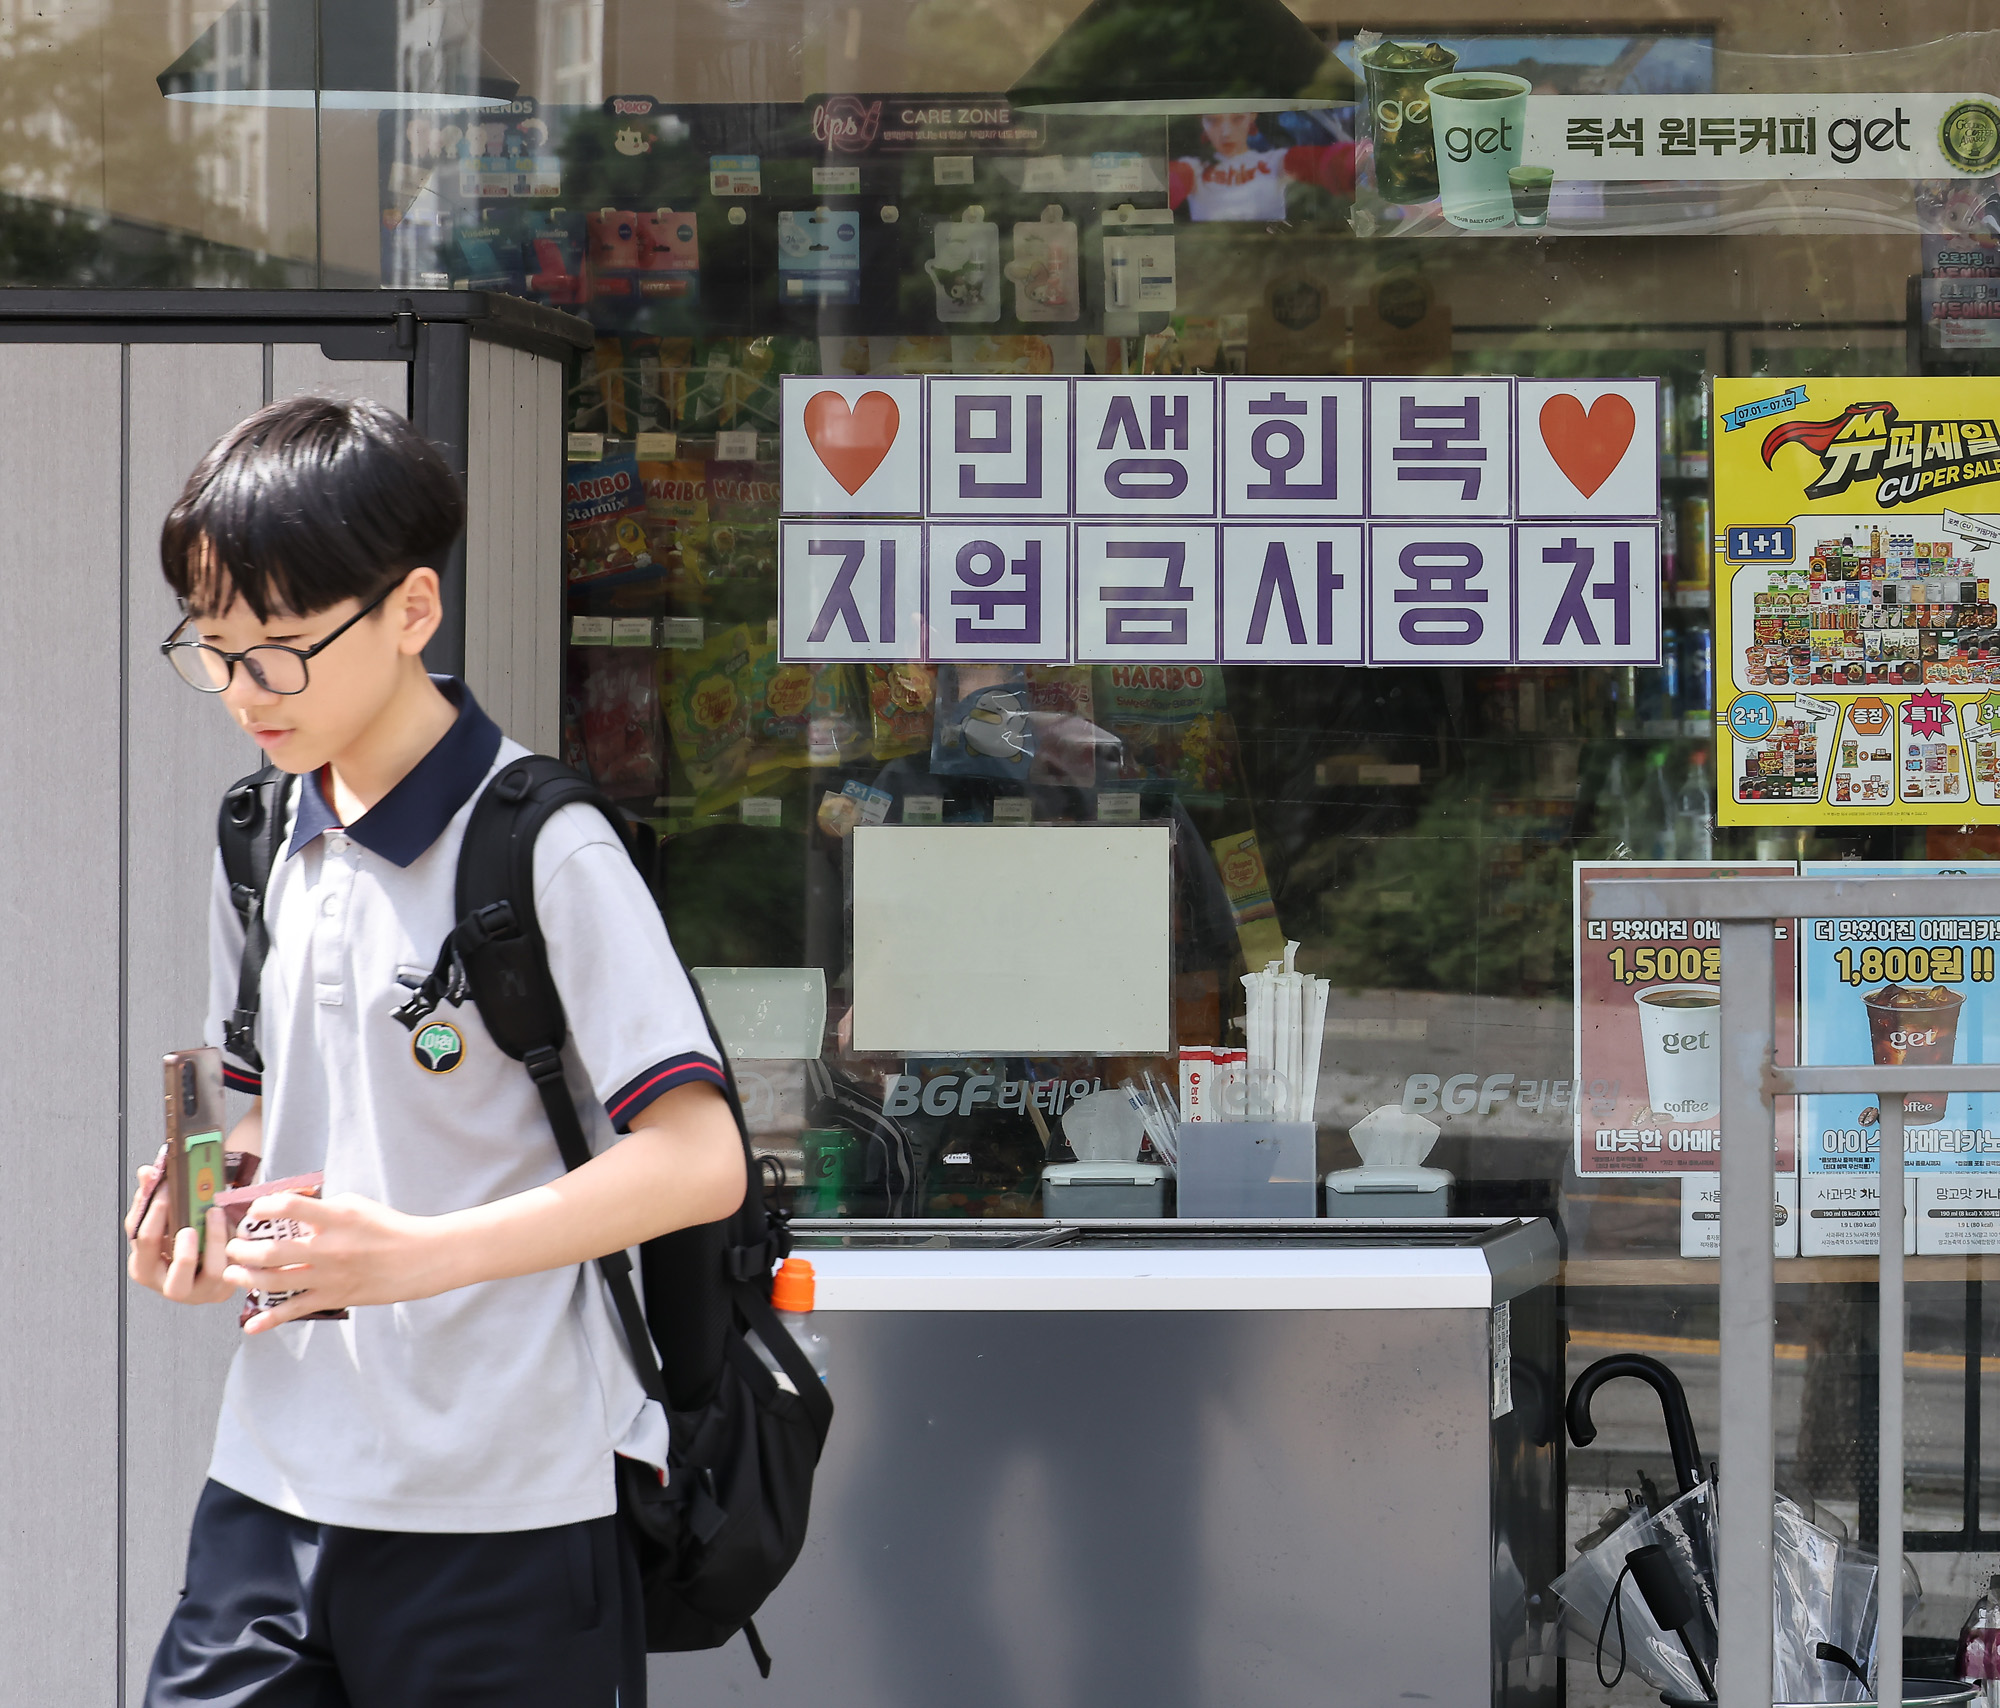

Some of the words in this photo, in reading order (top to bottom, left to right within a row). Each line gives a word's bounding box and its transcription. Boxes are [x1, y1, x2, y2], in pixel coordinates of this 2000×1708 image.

[901, 109, 952, 124] CARE
[957, 109, 1010, 124] ZONE
[1377, 99, 1430, 132] ge
[1444, 116, 1513, 163] get
[1566, 117, 1645, 157] 즉석
[1658, 116, 1817, 157] 원두커피
[1827, 107, 1911, 164] get
[1453, 215, 1469, 223] YOUR
[1485, 214, 1505, 224] COFFEE
[1738, 405, 1762, 419] 07.01
[1769, 397, 1793, 411] 07.15
[954, 392, 1487, 501] 민생회복
[567, 471, 631, 503] ARIBO
[1877, 464, 1961, 502] CUPER
[567, 499, 626, 522] Starmix
[1737, 530, 1786, 556] 1+1
[1733, 706, 1770, 726] 2+1
[1852, 707, 1884, 726] 증정
[1910, 705, 1944, 724] 특가
[846, 782, 869, 798] 2+1
[1587, 919, 1607, 941] 더
[1612, 919, 1688, 941] 맛있어진
[1815, 920, 1834, 941] 더
[1839, 920, 1916, 941] 맛있어진
[1834, 946, 1965, 987] 1,800원
[1971, 946, 1995, 983] !!
[1662, 1030, 1711, 1055] get
[1888, 1028, 1938, 1051] get
[1663, 1099, 1710, 1113] coffee
[1595, 1129, 1664, 1152] 따듯한
[1822, 1128, 1880, 1153] 아이스
[1700, 1191, 1720, 1203] 자몽
[1817, 1188, 1857, 1200] 사과맛
[1936, 1187, 1973, 1200] 망고맛
